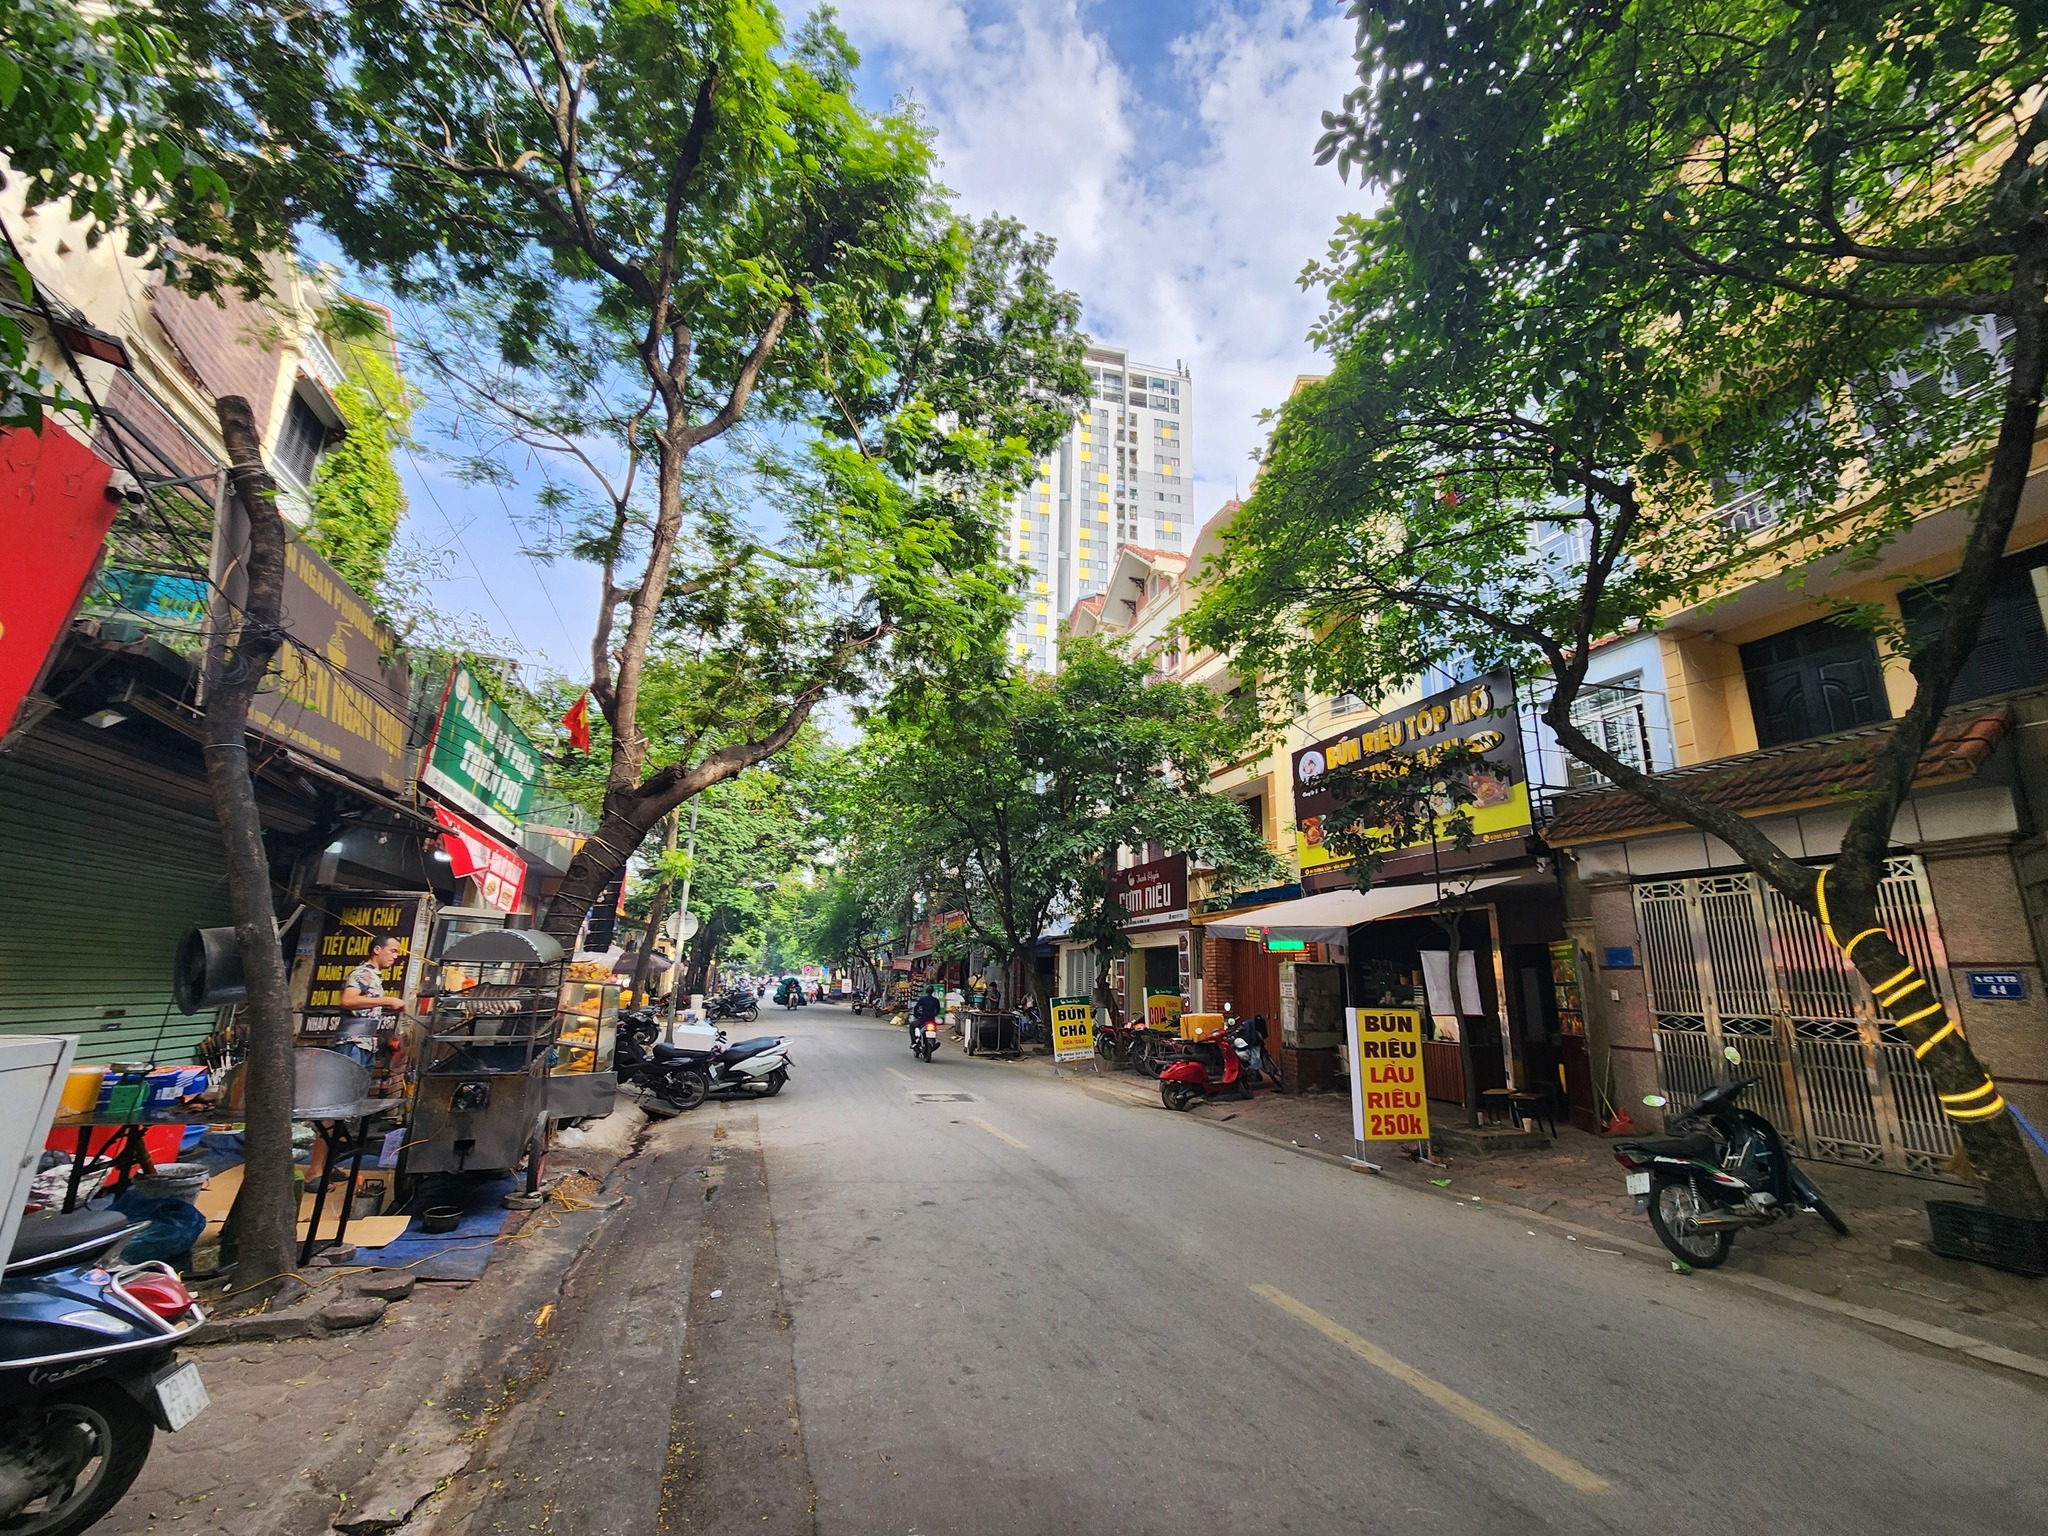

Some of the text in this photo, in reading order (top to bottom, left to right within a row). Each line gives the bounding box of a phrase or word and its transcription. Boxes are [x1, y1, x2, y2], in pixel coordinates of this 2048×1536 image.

[299, 554, 334, 605] NGAN
[331, 676, 373, 742] NGAN
[461, 693, 498, 745] BÁNH
[1326, 736, 1361, 770] BÚN
[1362, 721, 1403, 757] RIÊU
[460, 740, 503, 795] THIÊN
[1145, 882, 1171, 910] NIÊU
[340, 904, 402, 931] NGAN CHẶT
[322, 930, 346, 956] TIẾT
[310, 987, 330, 1006] BÚN
[1058, 1006, 1086, 1021] BÚN
[1364, 1012, 1412, 1032] BÚN
[306, 1016, 330, 1035] NHẬN
[1060, 1020, 1087, 1037] CHẢ
[1364, 1038, 1416, 1058] RIÊU
[1370, 1060, 1414, 1083] LẨU
[1367, 1088, 1421, 1109] RIÊU
[1371, 1113, 1422, 1136] 250k
